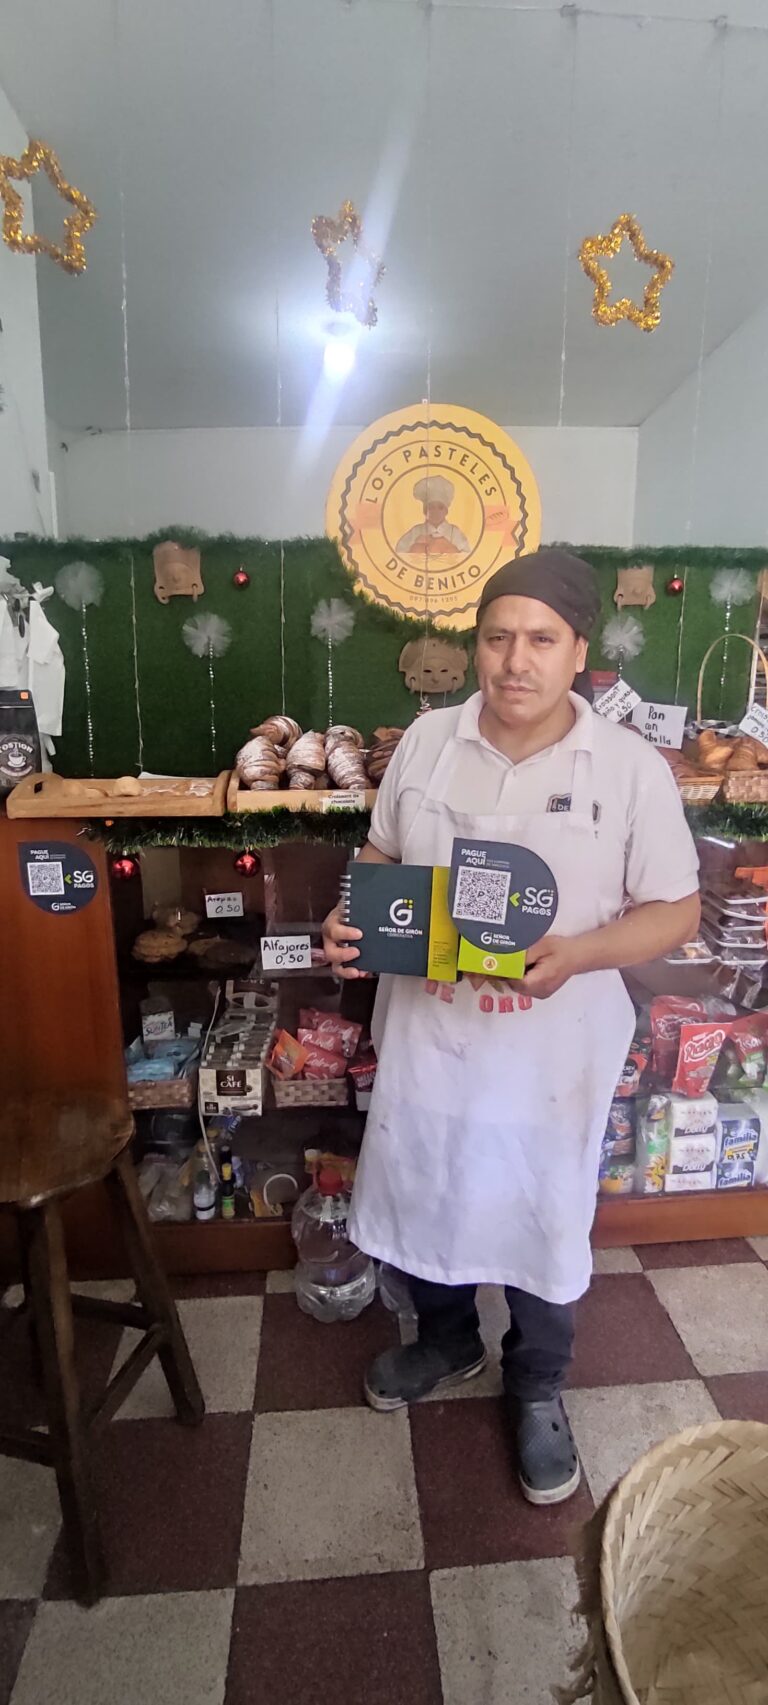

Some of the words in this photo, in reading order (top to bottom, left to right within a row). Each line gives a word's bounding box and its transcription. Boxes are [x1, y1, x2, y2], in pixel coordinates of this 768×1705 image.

[366, 464, 394, 504] LOS
[403, 445, 497, 497] PASTELES
[385, 557, 408, 580] DE
[414, 564, 482, 590] BENITO
[648, 705, 665, 720] Pan
[644, 722, 658, 732] con
[461, 848, 487, 858] PAGUE
[73, 870, 94, 883] SG
[523, 886, 554, 907] SG
[521, 905, 552, 917] PAGOS
[263, 940, 309, 956] Alfajores
[275, 954, 304, 966] 0,50
[479, 992, 533, 1013] ORO
[725, 1132, 757, 1146] familia
[720, 1173, 751, 1186] familia
